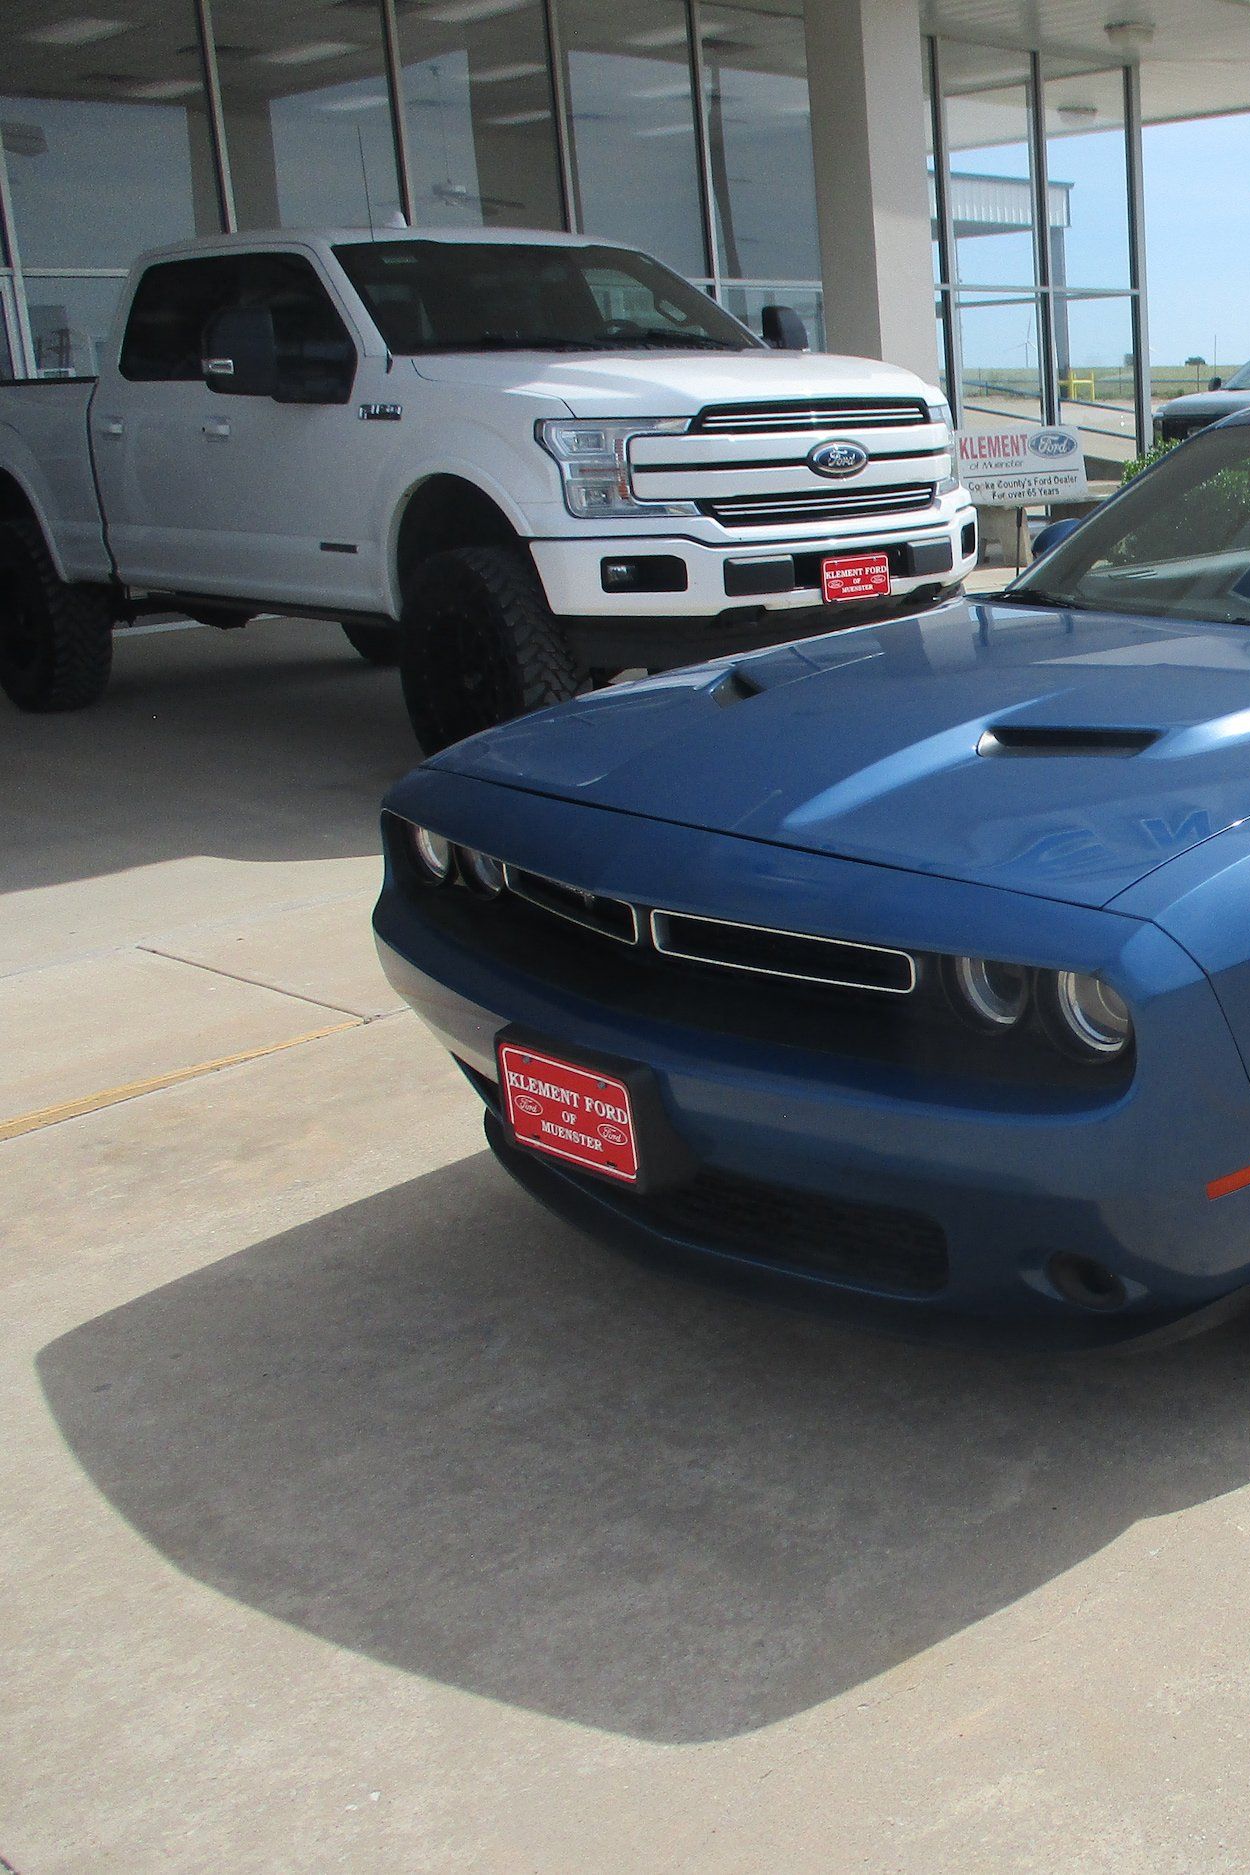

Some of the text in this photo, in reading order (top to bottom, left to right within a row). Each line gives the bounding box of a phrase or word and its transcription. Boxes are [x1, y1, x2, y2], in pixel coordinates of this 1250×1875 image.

[959, 434, 1028, 460] KLEMENT
[1039, 435, 1070, 453] Ford
[828, 448, 856, 467] Ford
[968, 475, 1078, 491] Coke County's Ford Dealer
[1007, 490, 1025, 499] over
[1027, 488, 1037, 497] 65
[1038, 486, 1060, 496] Years
[825, 568, 864, 580] KLEMENT
[864, 565, 887, 575] FORD
[507, 1070, 628, 1125] KLEMENT FORD
[561, 1110, 577, 1125] OF
[541, 1120, 604, 1152] MUENSTER
